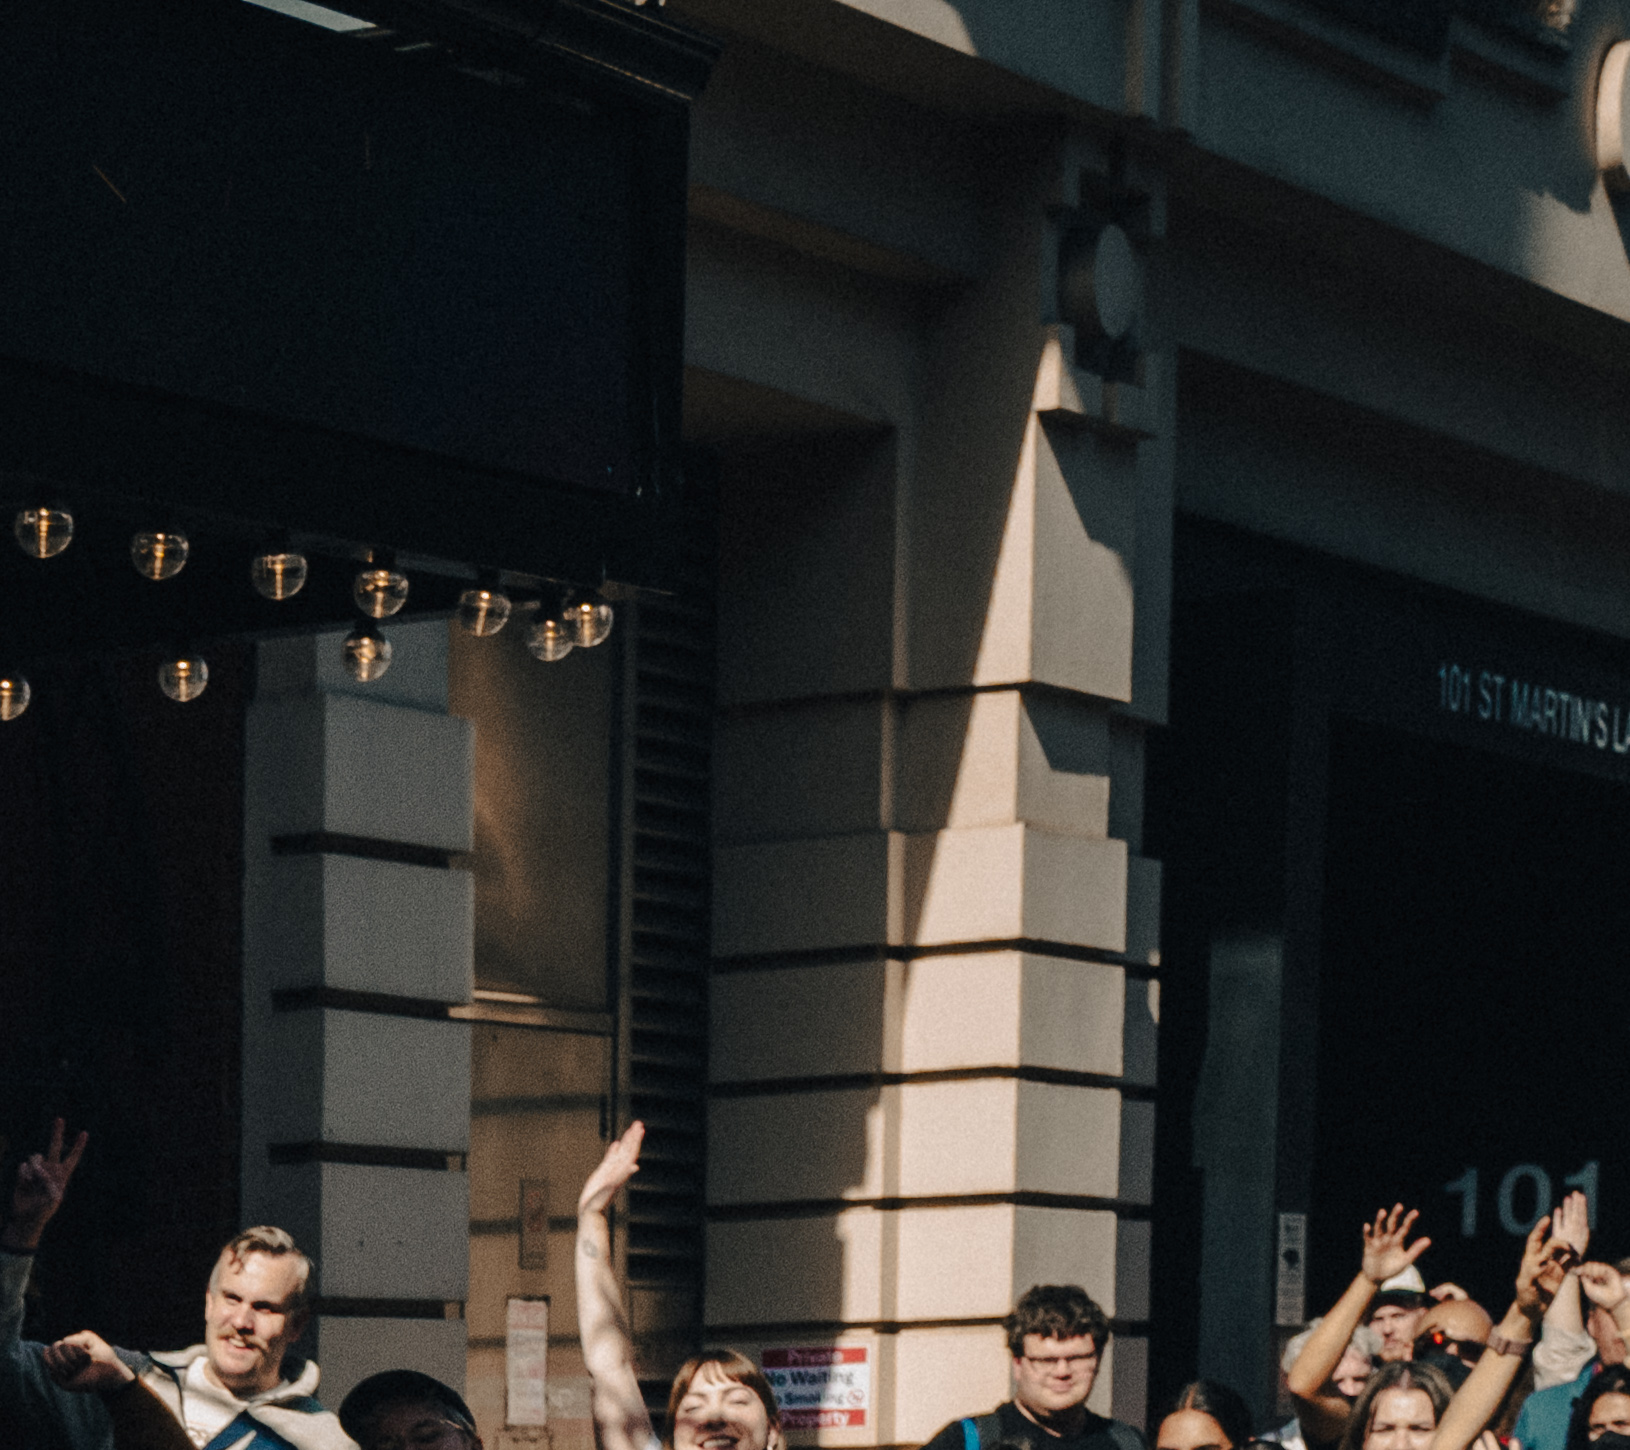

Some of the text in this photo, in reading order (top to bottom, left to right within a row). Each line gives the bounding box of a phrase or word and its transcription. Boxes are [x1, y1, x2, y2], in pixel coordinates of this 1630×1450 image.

[1438, 662, 1472, 713] 101
[1477, 669, 1507, 722] ST
[1510, 680, 1610, 750] MARTIN'S
[1443, 1161, 1602, 1238] 101
[784, 1392, 844, 1407] Smoking
[790, 1370, 854, 1387] Waiting
